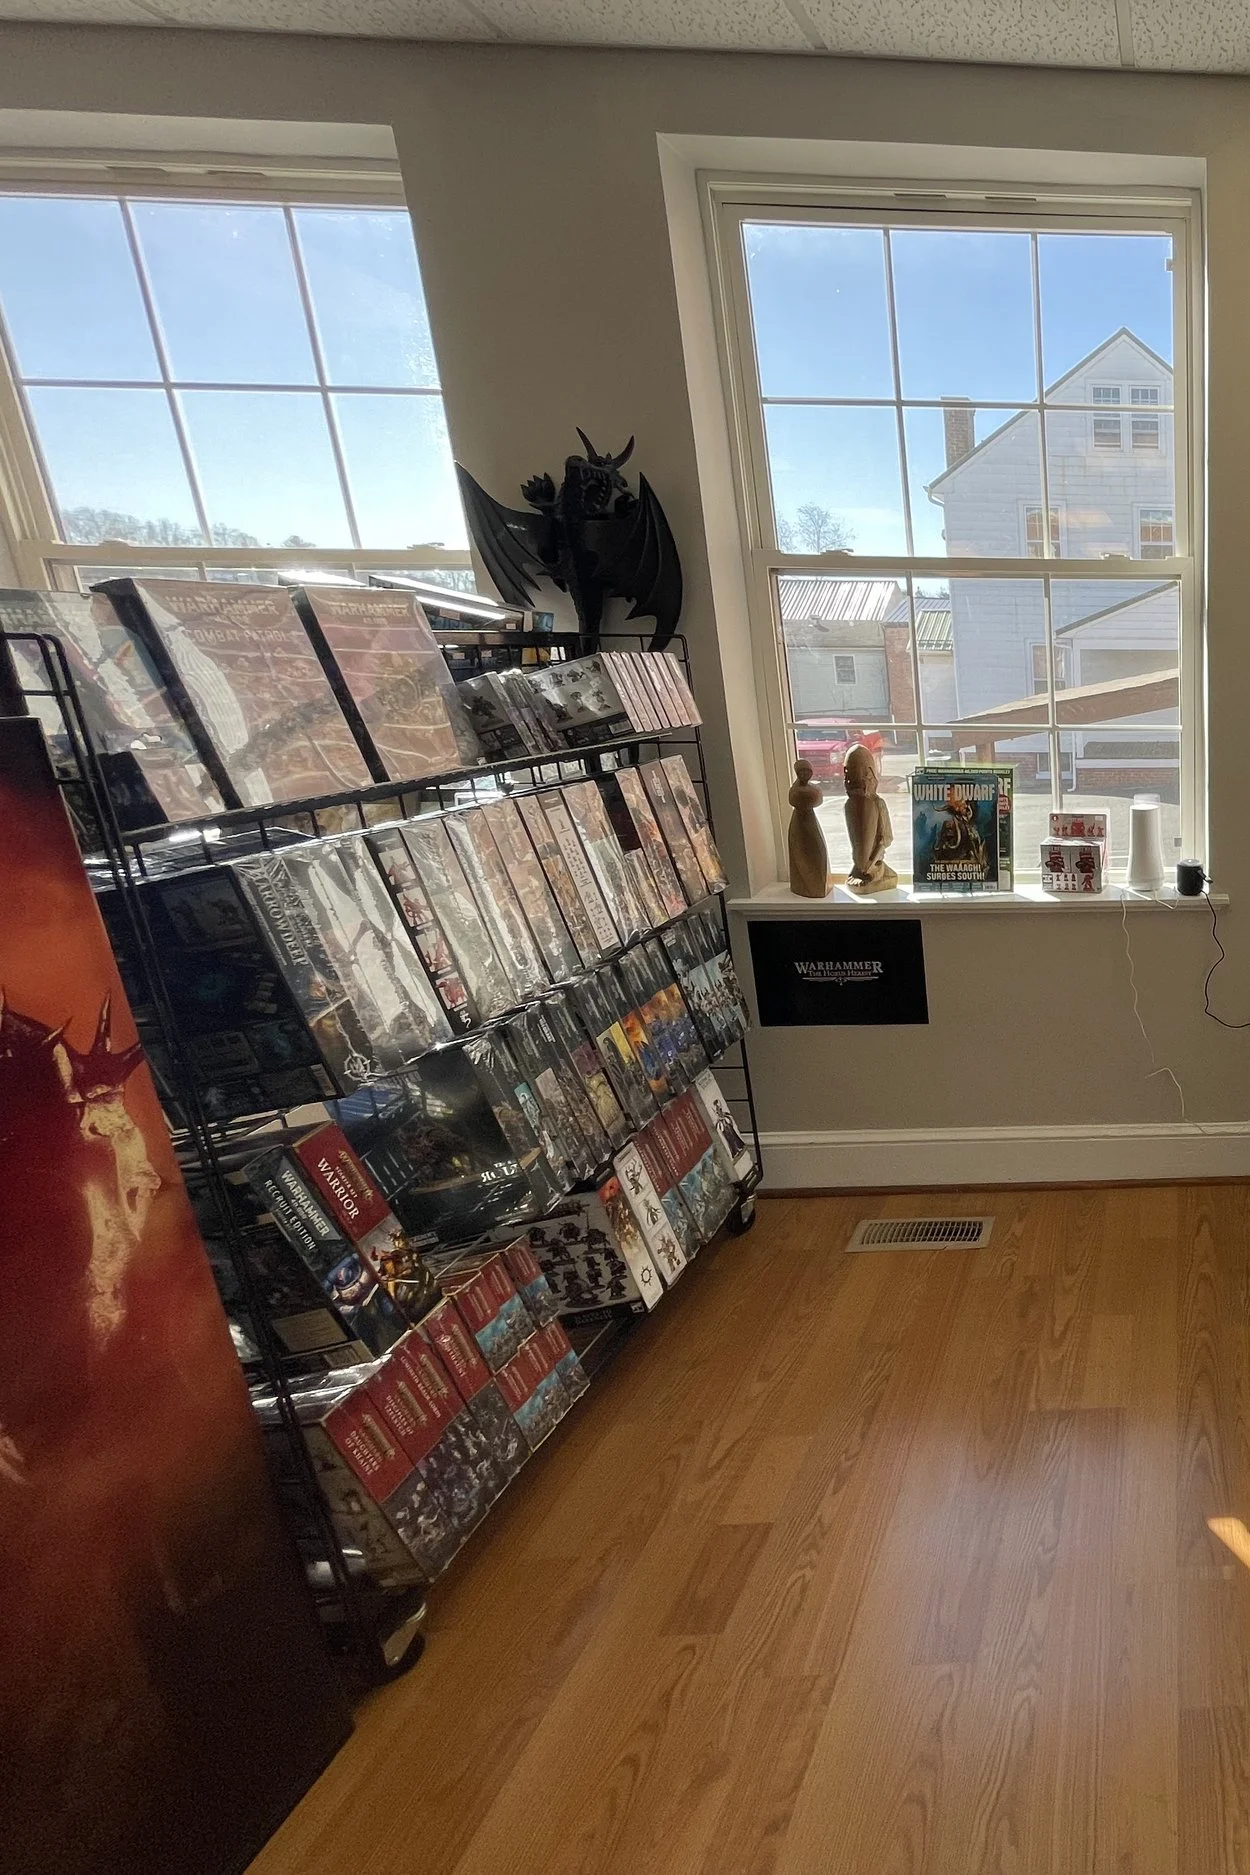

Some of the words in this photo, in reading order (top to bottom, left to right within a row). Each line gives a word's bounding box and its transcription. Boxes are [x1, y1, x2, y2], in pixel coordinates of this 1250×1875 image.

[913, 784, 951, 800] WHITE
[954, 784, 995, 800] DWARF
[930, 864, 947, 872] THE
[947, 863, 981, 872] WAAAGH!
[926, 872, 956, 881] SURGES
[957, 872, 985, 881] SOUTH!
[793, 961, 884, 974] WARHAMMER
[317, 1157, 360, 1219] WARRIOR
[281, 1170, 330, 1237] WARHAMMER
[264, 1180, 293, 1215] RECRUIT
[290, 1215, 316, 1250] EDITION
[345, 1437, 355, 1448] OF
